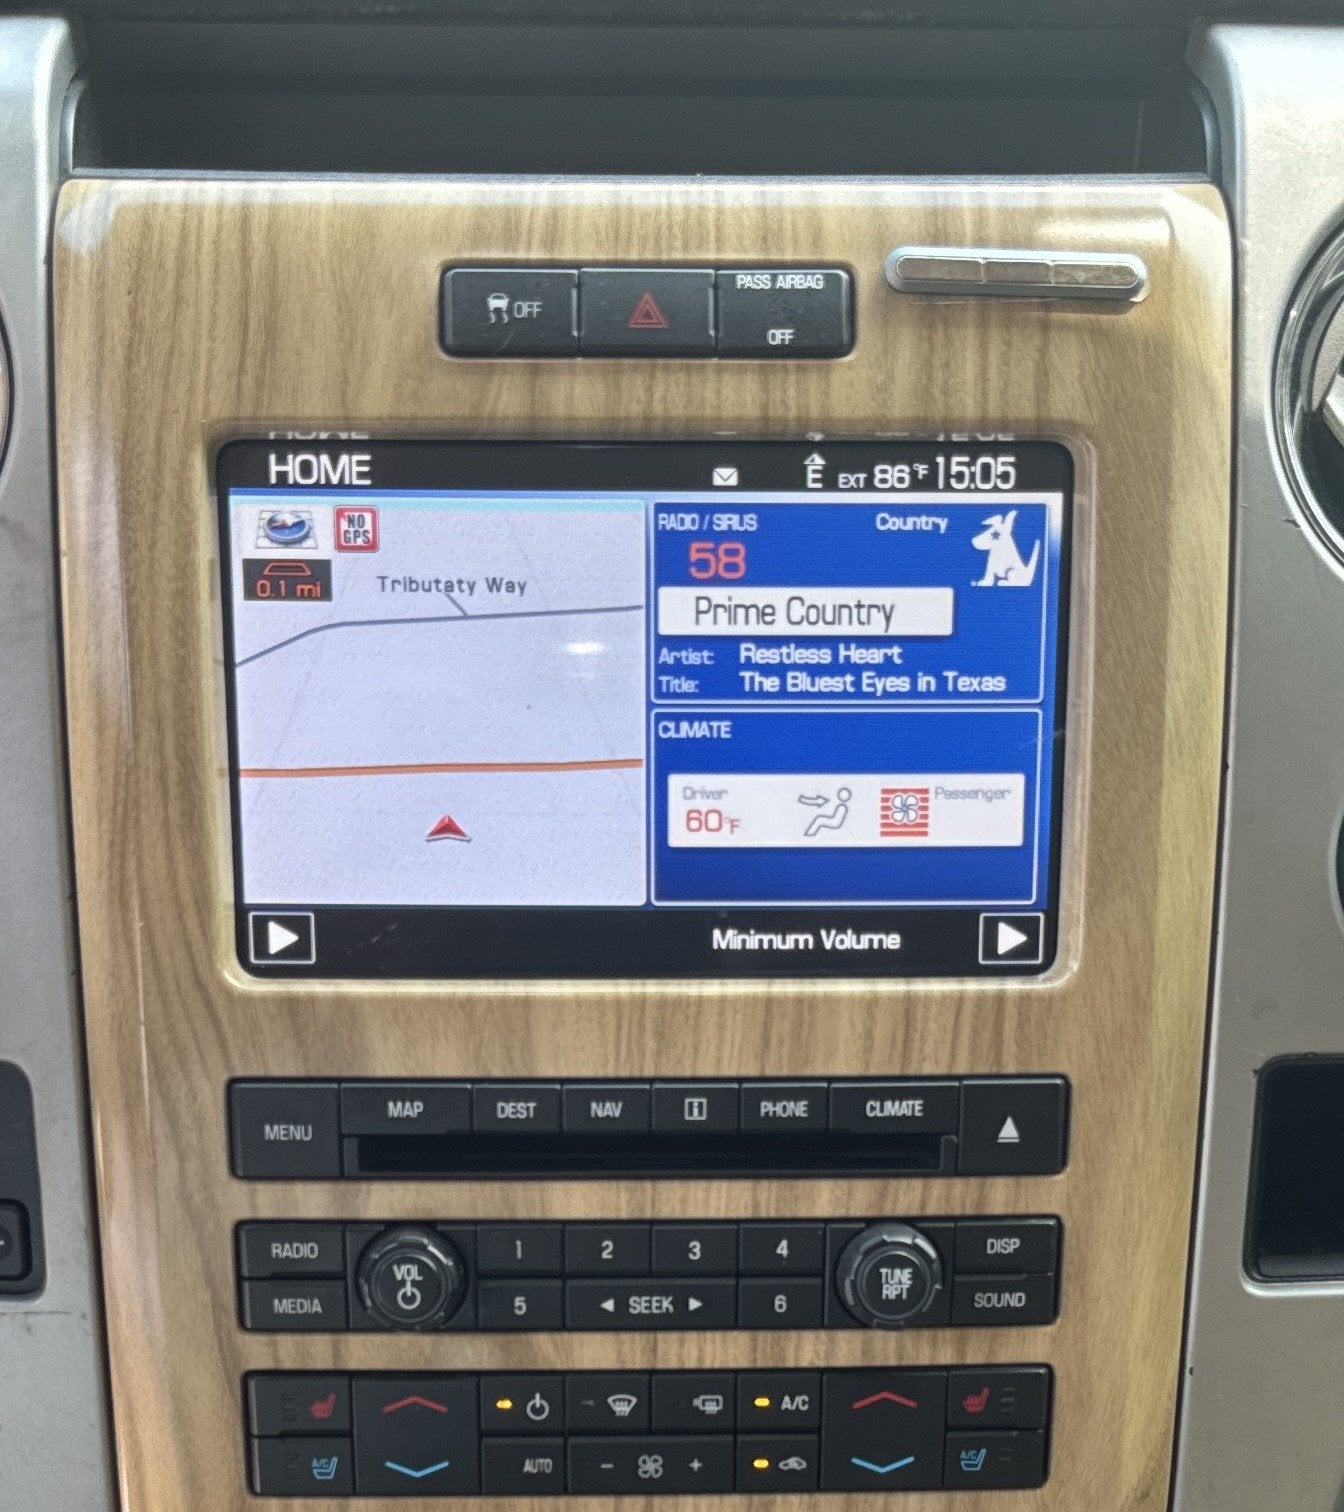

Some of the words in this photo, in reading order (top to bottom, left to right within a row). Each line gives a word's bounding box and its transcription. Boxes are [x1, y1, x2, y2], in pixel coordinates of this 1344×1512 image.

[736, 275, 772, 289] PASS
[775, 275, 824, 290] AIRBAG
[513, 302, 542, 318] OFF
[767, 329, 794, 345] OFF
[268, 453, 372, 486] HOME
[806, 465, 823, 489] E
[838, 473, 867, 489] EXT
[935, 456, 1016, 490] 15:05
[346, 514, 367, 529] NO
[658, 513, 700, 532] RADIO
[713, 513, 759, 532] SIRIUS
[875, 513, 948, 535] Country
[342, 529, 371, 545] GPS
[688, 541, 747, 580] 58
[256, 579, 287, 598] 0.1
[296, 580, 321, 598] mi
[485, 577, 528, 597] Way
[694, 595, 776, 627] Prime
[785, 595, 895, 634] Country
[658, 648, 715, 666] Artist:
[739, 643, 833, 665] Restless
[838, 643, 903, 665] Heart
[658, 676, 699, 694] Title:
[739, 671, 780, 693] The
[786, 671, 855, 693] Bluest
[861, 671, 911, 697] Eyes
[917, 671, 936, 693] in
[943, 671, 1007, 693] Texas
[658, 720, 733, 740] CLIMATE
[682, 785, 729, 801] Driver
[934, 786, 1011, 804] Passenger
[712, 927, 814, 950] Minimum
[820, 927, 901, 950] Volume
[387, 1101, 424, 1119] MAP
[496, 1101, 537, 1119] DEST
[590, 1101, 623, 1119] NAV
[760, 1100, 809, 1118] PHONE
[865, 1099, 924, 1118] CLIMATE
[264, 1124, 312, 1142] MENU
[271, 1242, 319, 1259] RADIO
[600, 1240, 614, 1259] 2
[687, 1240, 701, 1260] 3
[775, 1239, 789, 1259] 4
[986, 1238, 1021, 1255] DISP
[392, 1264, 423, 1282] VOL
[879, 1267, 913, 1286] TUNE
[881, 1283, 908, 1300] RPT
[973, 1291, 1026, 1308] SOUND
[273, 1298, 322, 1315] MEDIA
[513, 1296, 527, 1315] 5
[628, 1296, 674, 1315] SEEK
[773, 1295, 787, 1314] 6
[780, 1394, 810, 1412] A/C
[523, 1457, 553, 1474] AUTO
